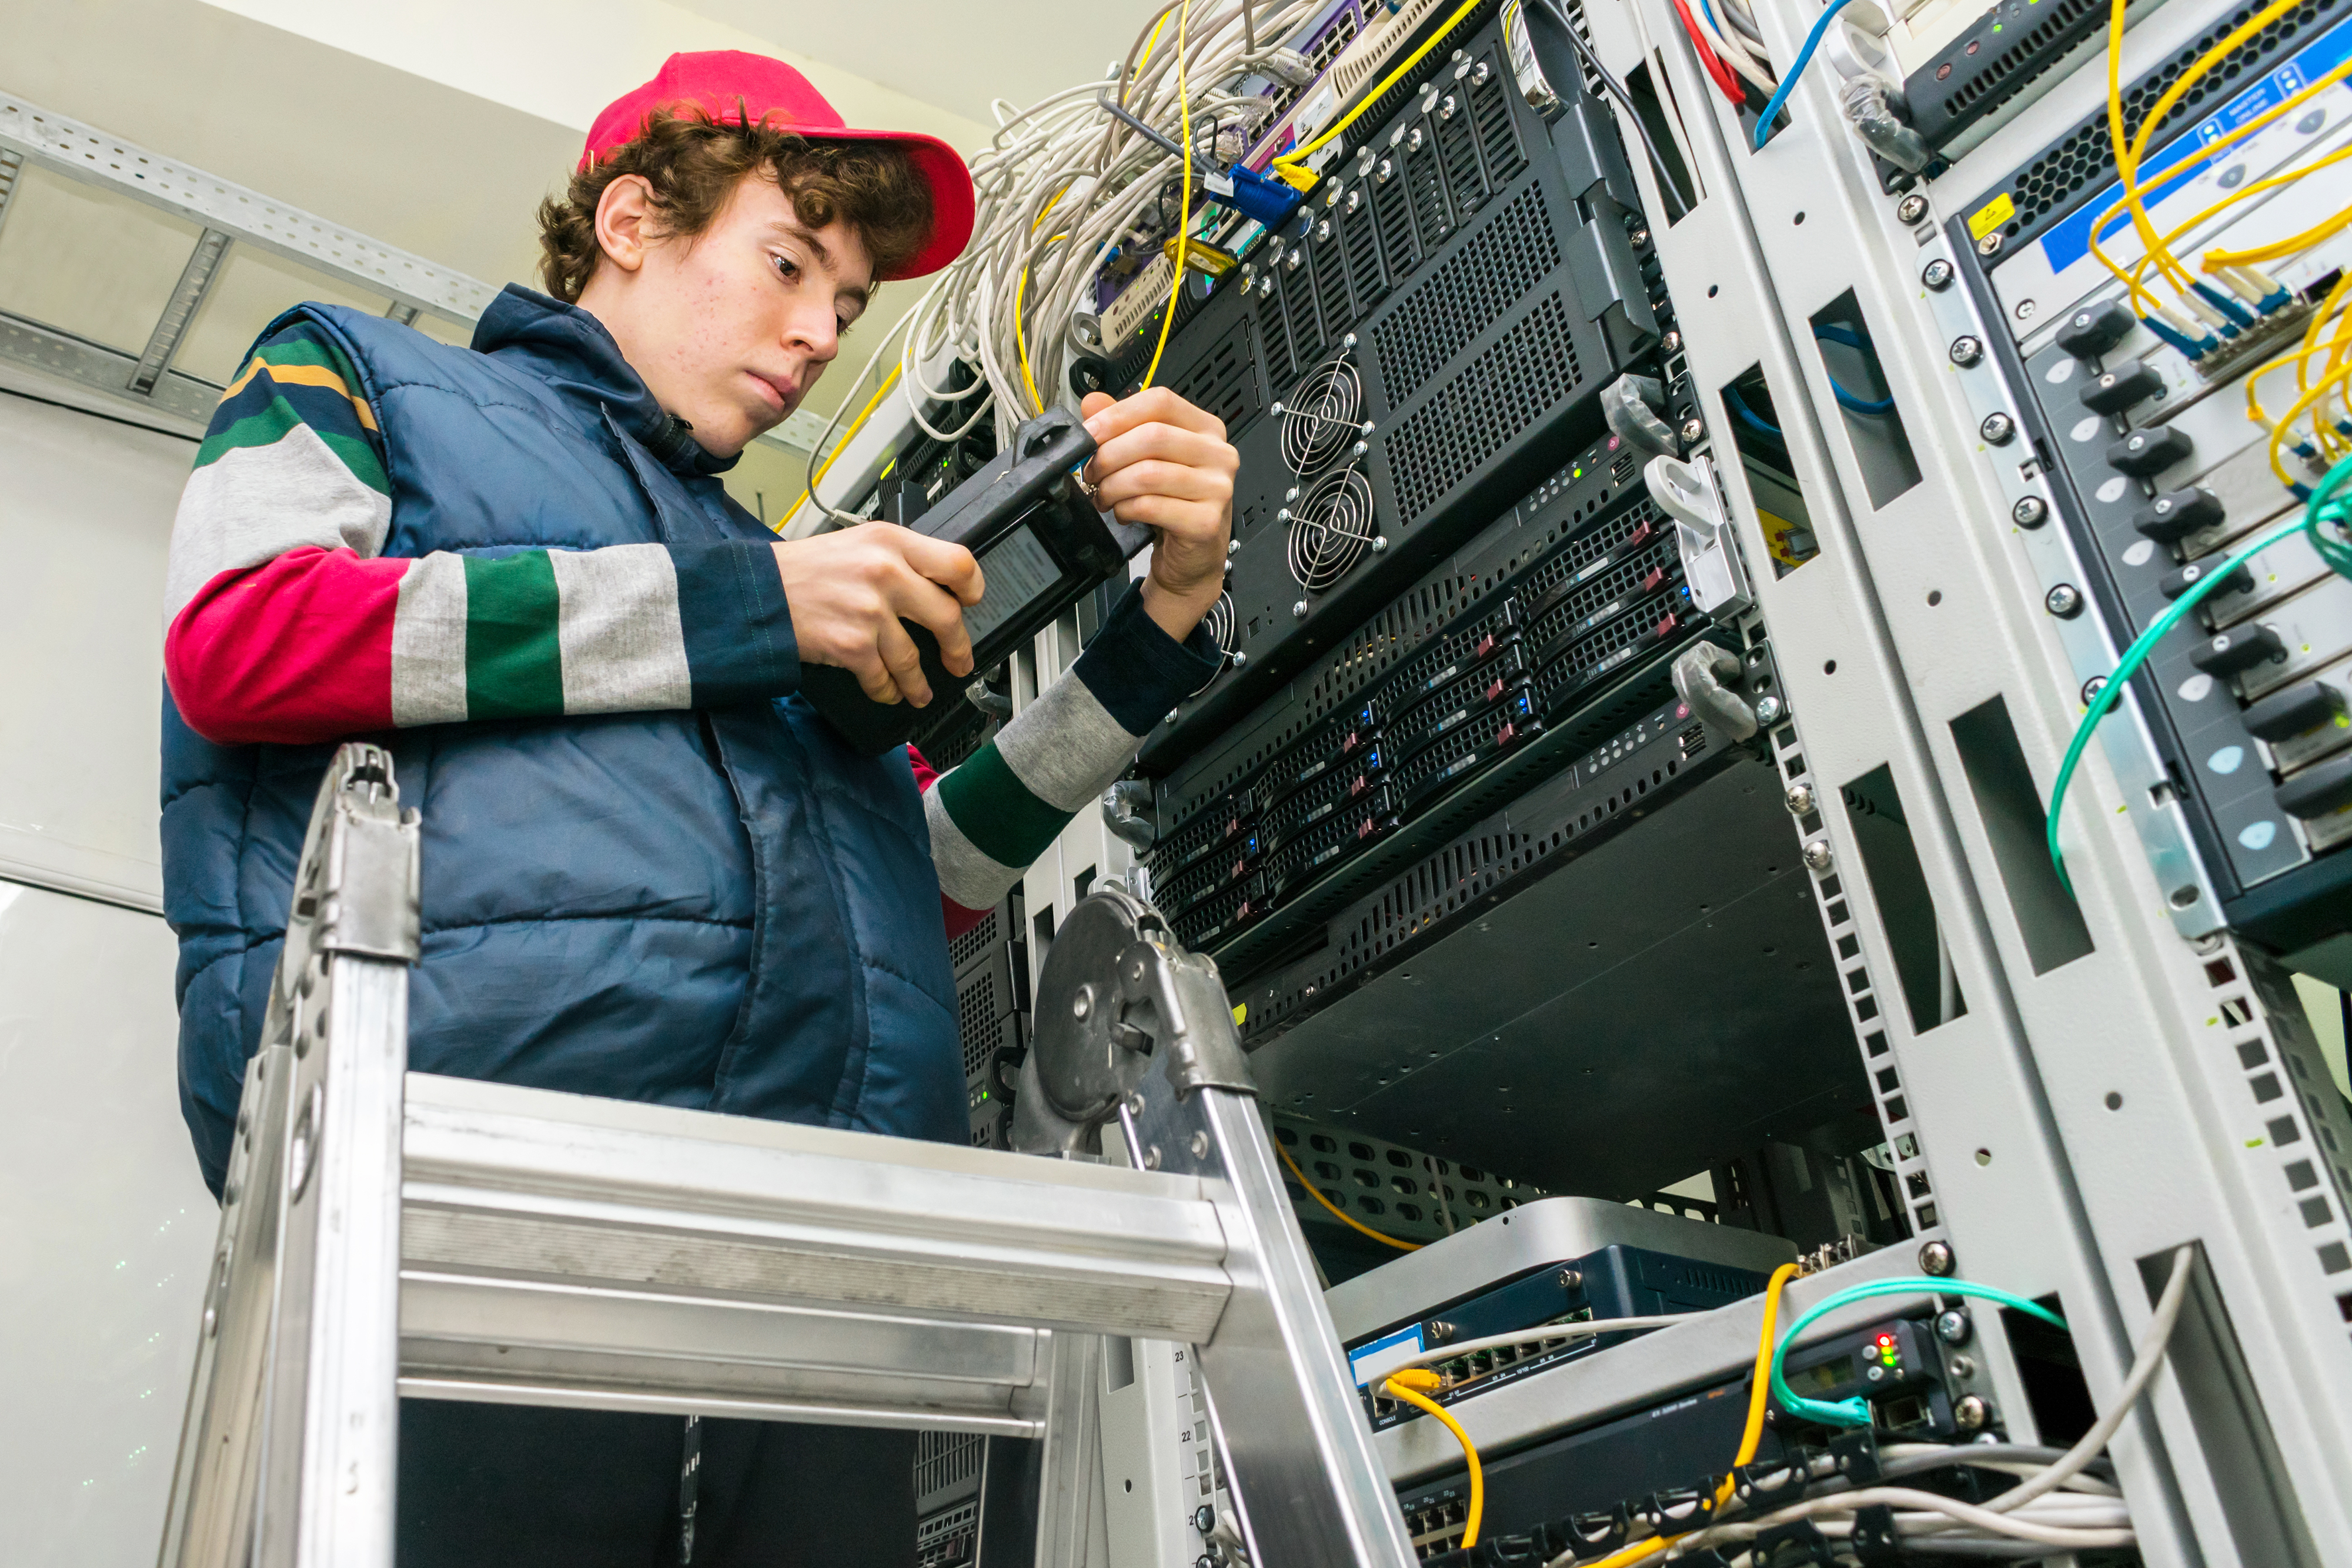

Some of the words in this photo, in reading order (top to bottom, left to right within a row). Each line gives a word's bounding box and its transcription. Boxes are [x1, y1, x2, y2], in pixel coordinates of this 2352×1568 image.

[1175, 1350, 1184, 1362] 23
[1379, 1416, 1396, 1426] CONSOLE
[1181, 1430, 1191, 1442] 22
